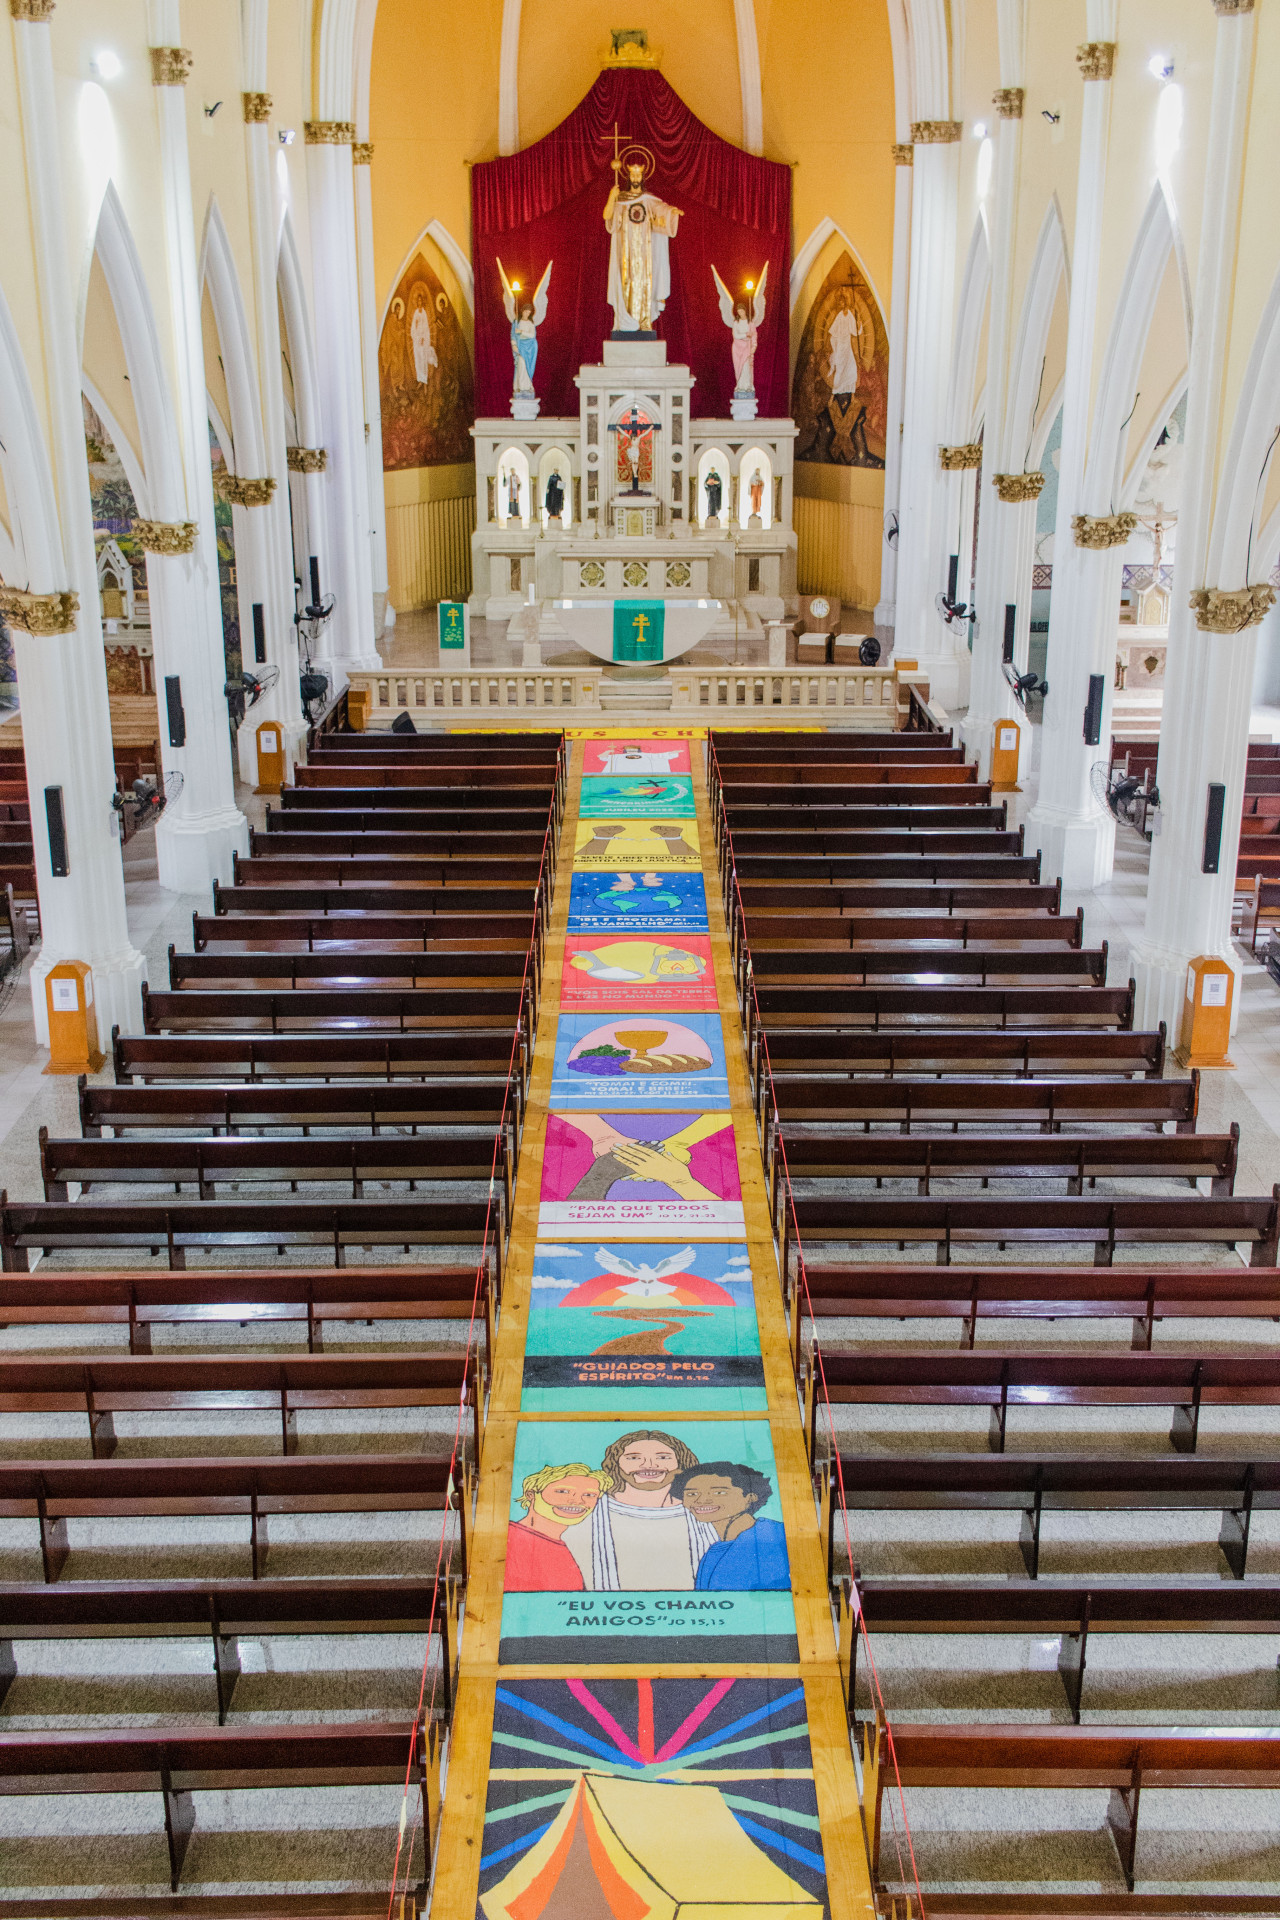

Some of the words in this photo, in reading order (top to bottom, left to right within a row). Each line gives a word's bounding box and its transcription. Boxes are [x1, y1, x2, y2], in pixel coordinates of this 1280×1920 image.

[573, 1362, 666, 1371] "GUIADOS
[671, 1362, 715, 1371] PELO
[578, 1370, 666, 1381] ESPÍRITO"
[557, 1600, 595, 1611] "EU
[603, 1600, 646, 1611] VOS
[654, 1600, 735, 1610] CHAMO
[565, 1615, 668, 1626] AMIGOS"
[668, 1618, 685, 1626] JO
